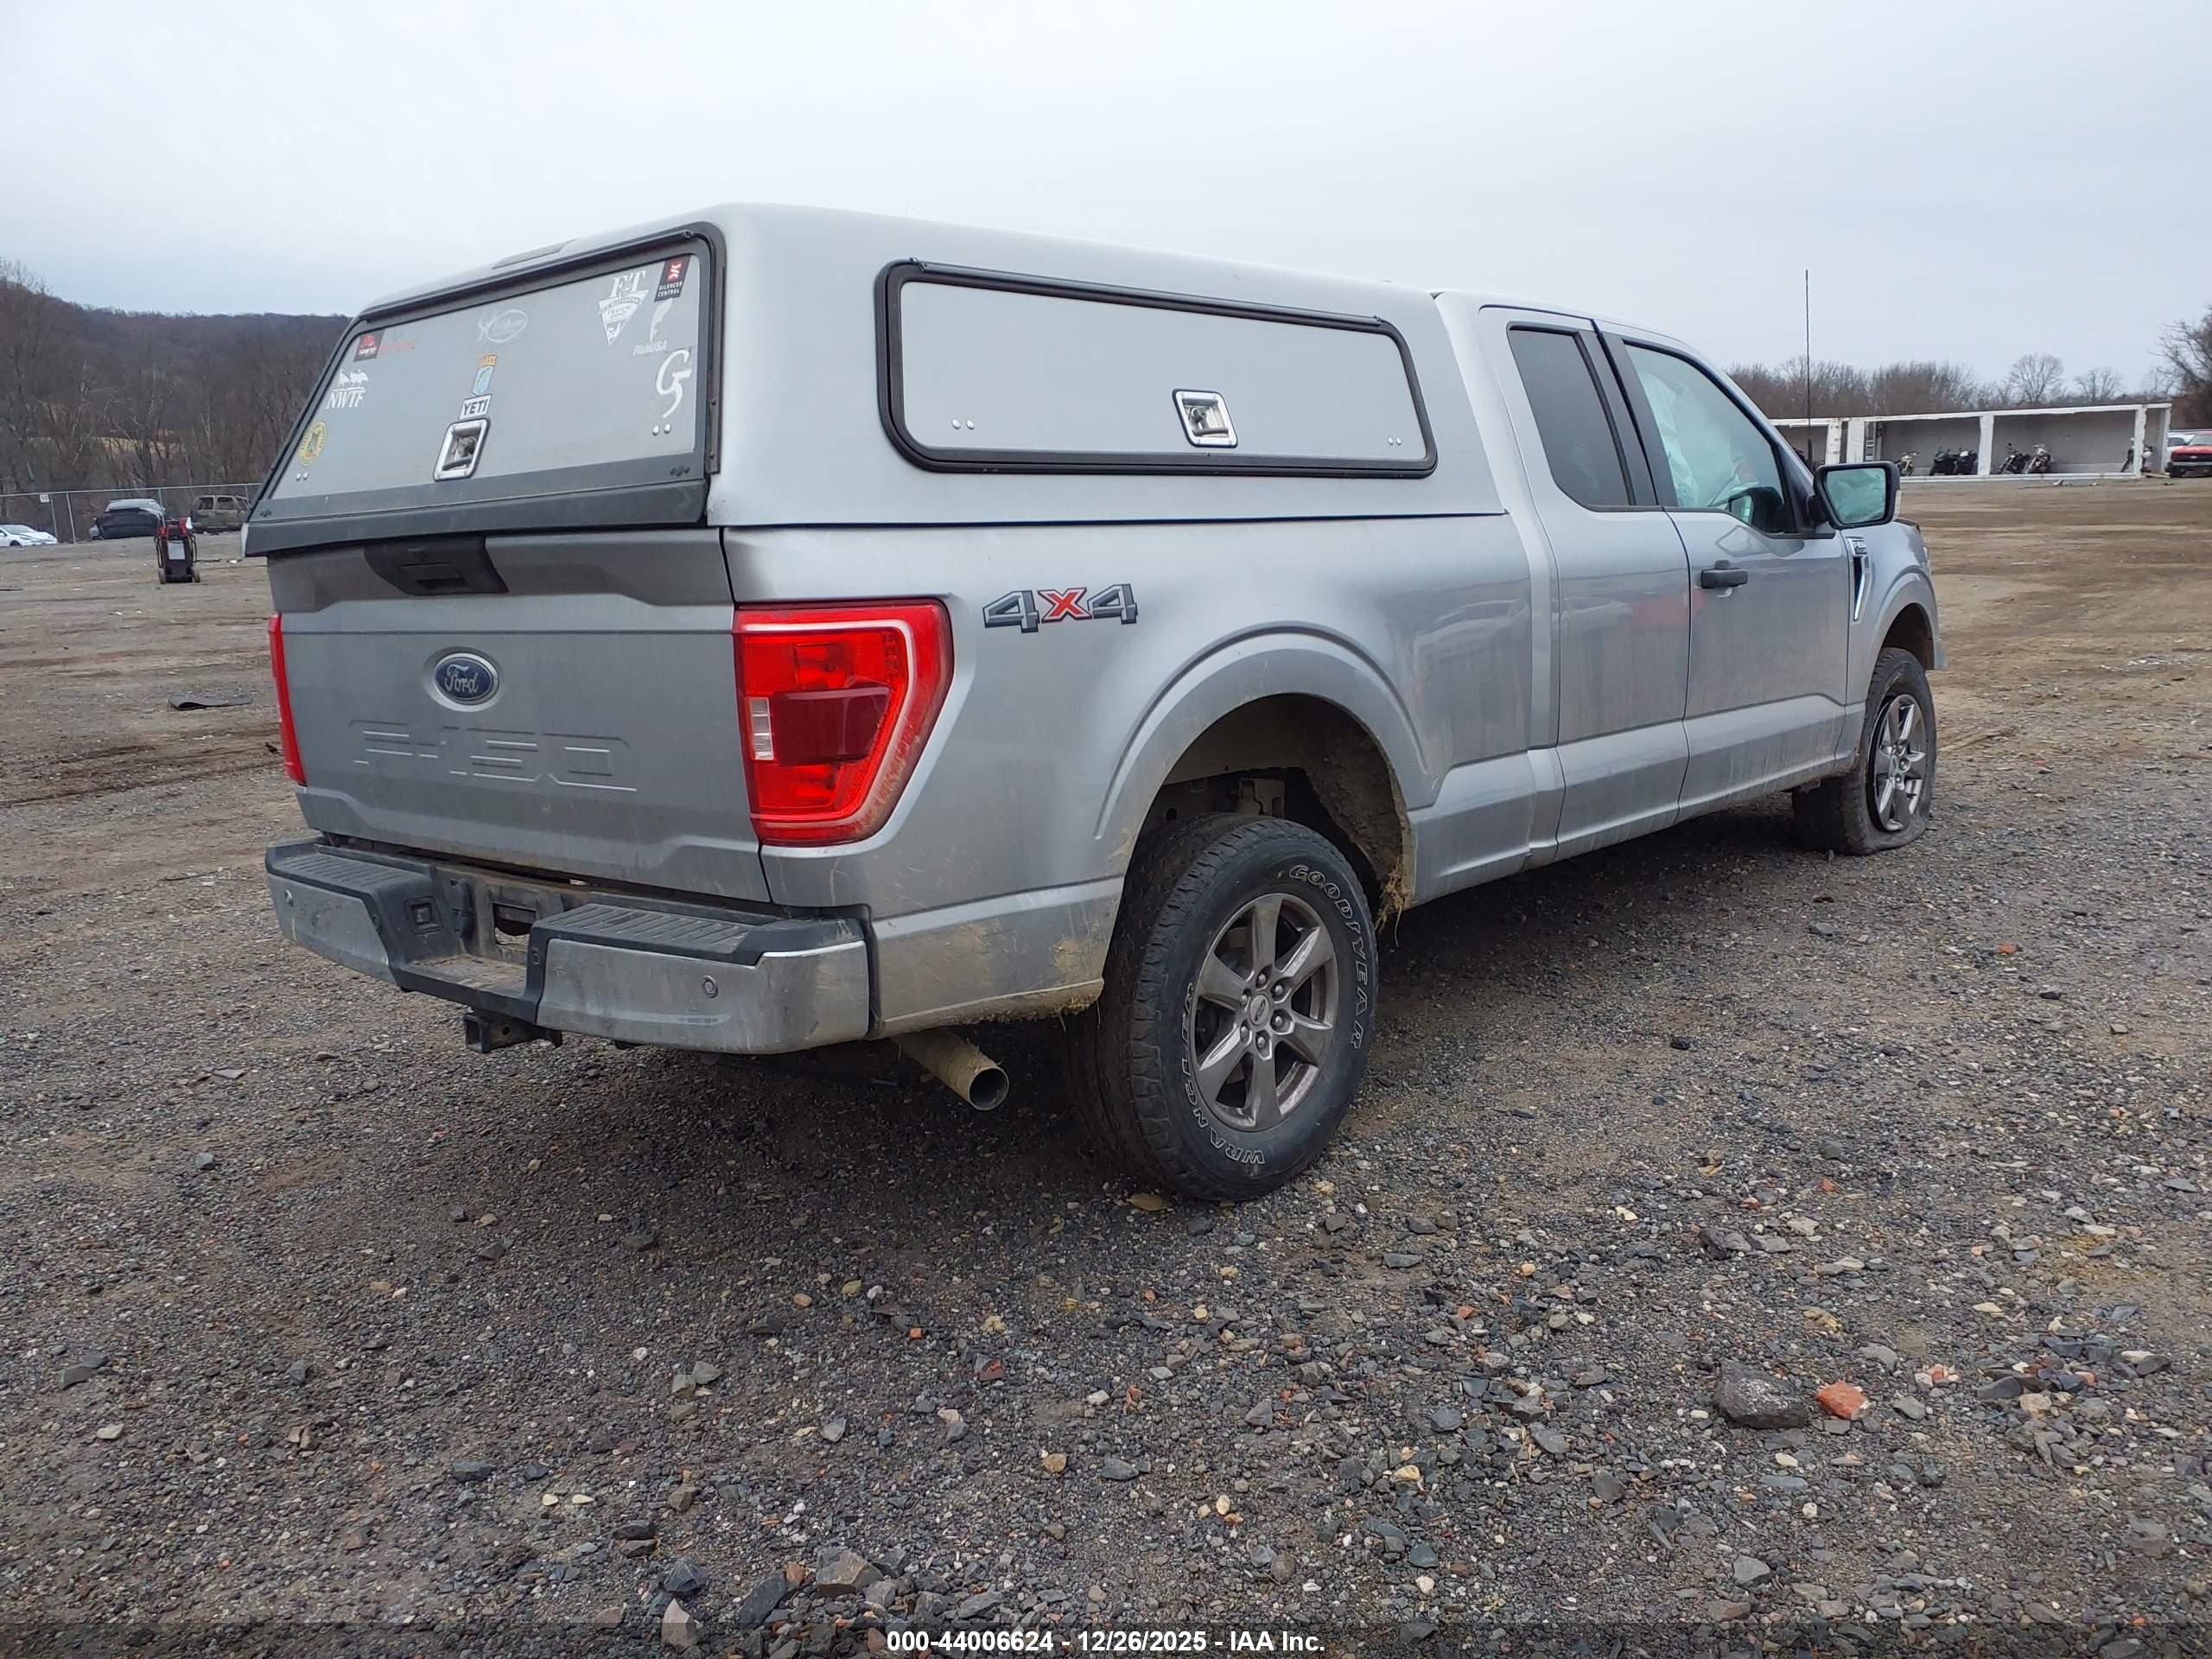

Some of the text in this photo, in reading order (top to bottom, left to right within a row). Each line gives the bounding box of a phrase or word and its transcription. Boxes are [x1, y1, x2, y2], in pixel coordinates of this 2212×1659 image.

[327, 389, 365, 410] NWTF
[463, 398, 489, 416] YETI
[444, 664, 479, 694] Ford
[348, 719, 638, 791] F-150
[1289, 865, 1368, 1050] GOODYEAR
